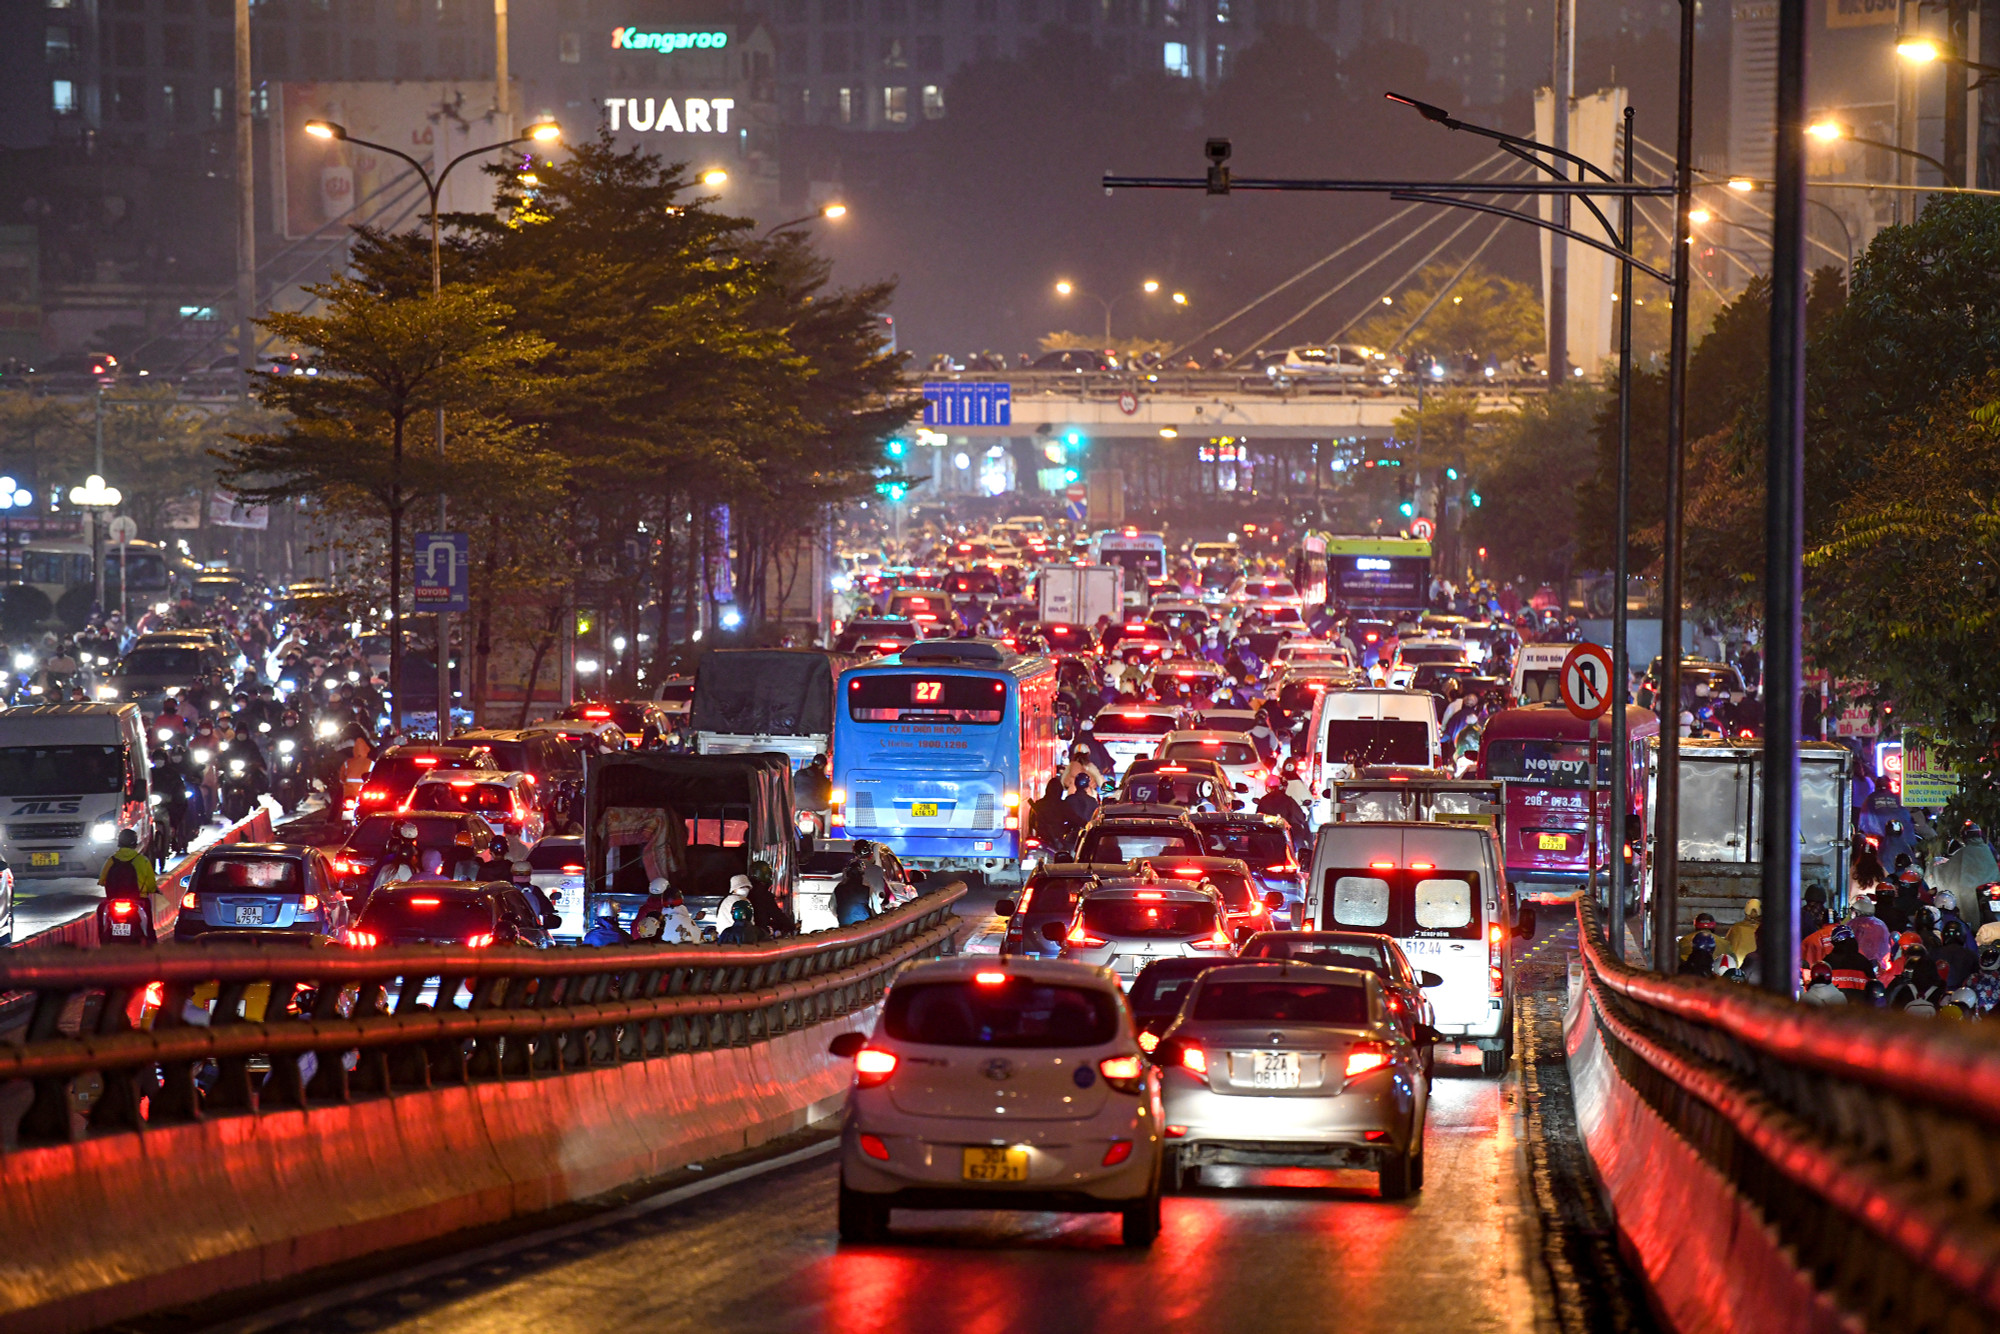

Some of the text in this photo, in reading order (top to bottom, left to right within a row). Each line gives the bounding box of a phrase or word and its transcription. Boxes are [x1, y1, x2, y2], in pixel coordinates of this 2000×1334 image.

[604, 97, 734, 133] TUART
[417, 588, 448, 596] TOYOTA
[916, 682, 941, 700] 27
[1525, 795, 1542, 806] 29B
[10, 802, 80, 816] ALS
[242, 907, 257, 915] 30A
[1265, 1057, 1288, 1071] 22A
